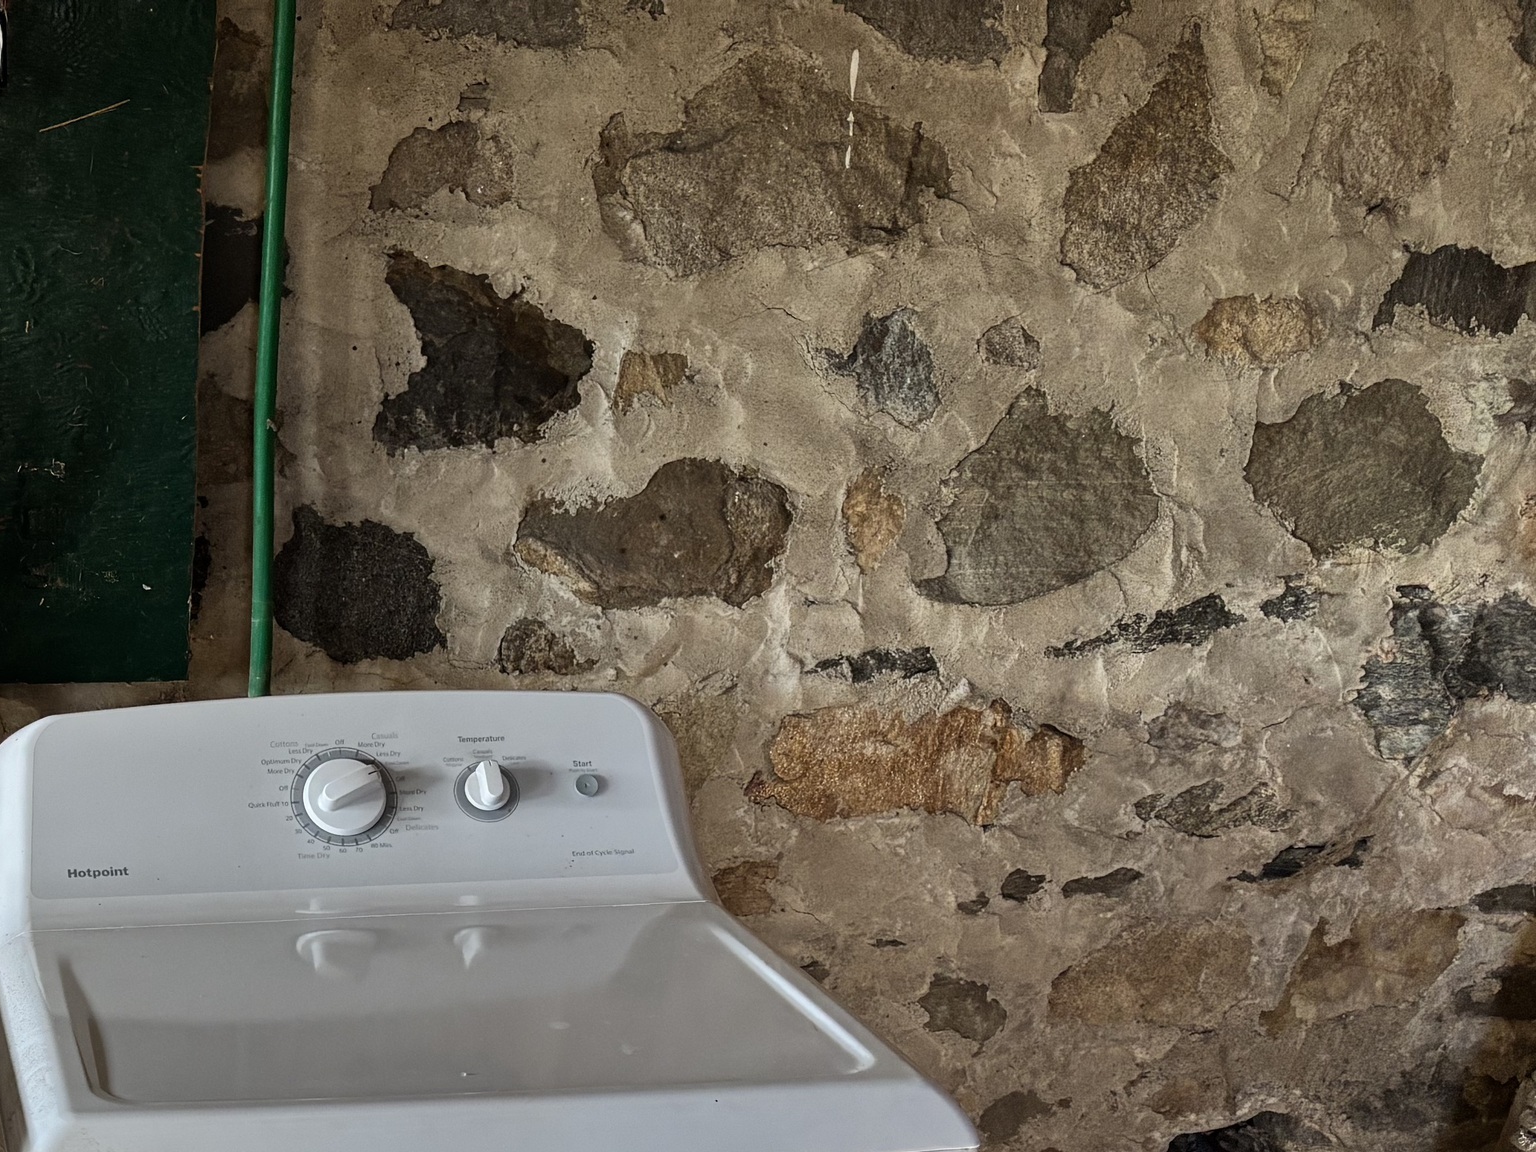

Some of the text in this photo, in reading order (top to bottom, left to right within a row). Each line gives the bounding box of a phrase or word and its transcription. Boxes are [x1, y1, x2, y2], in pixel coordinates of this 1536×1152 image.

[371, 732, 399, 740] Casuals
[457, 735, 506, 744] Temperature
[269, 741, 299, 749] Cottons
[390, 750, 401, 758] Dry
[572, 760, 593, 768] Start
[284, 767, 295, 775] Dry
[415, 788, 427, 796] Dry
[298, 852, 331, 860] Time Dry
[595, 849, 613, 857] Cycle
[614, 848, 635, 856] Signal
[66, 866, 130, 879] Hotpoint
